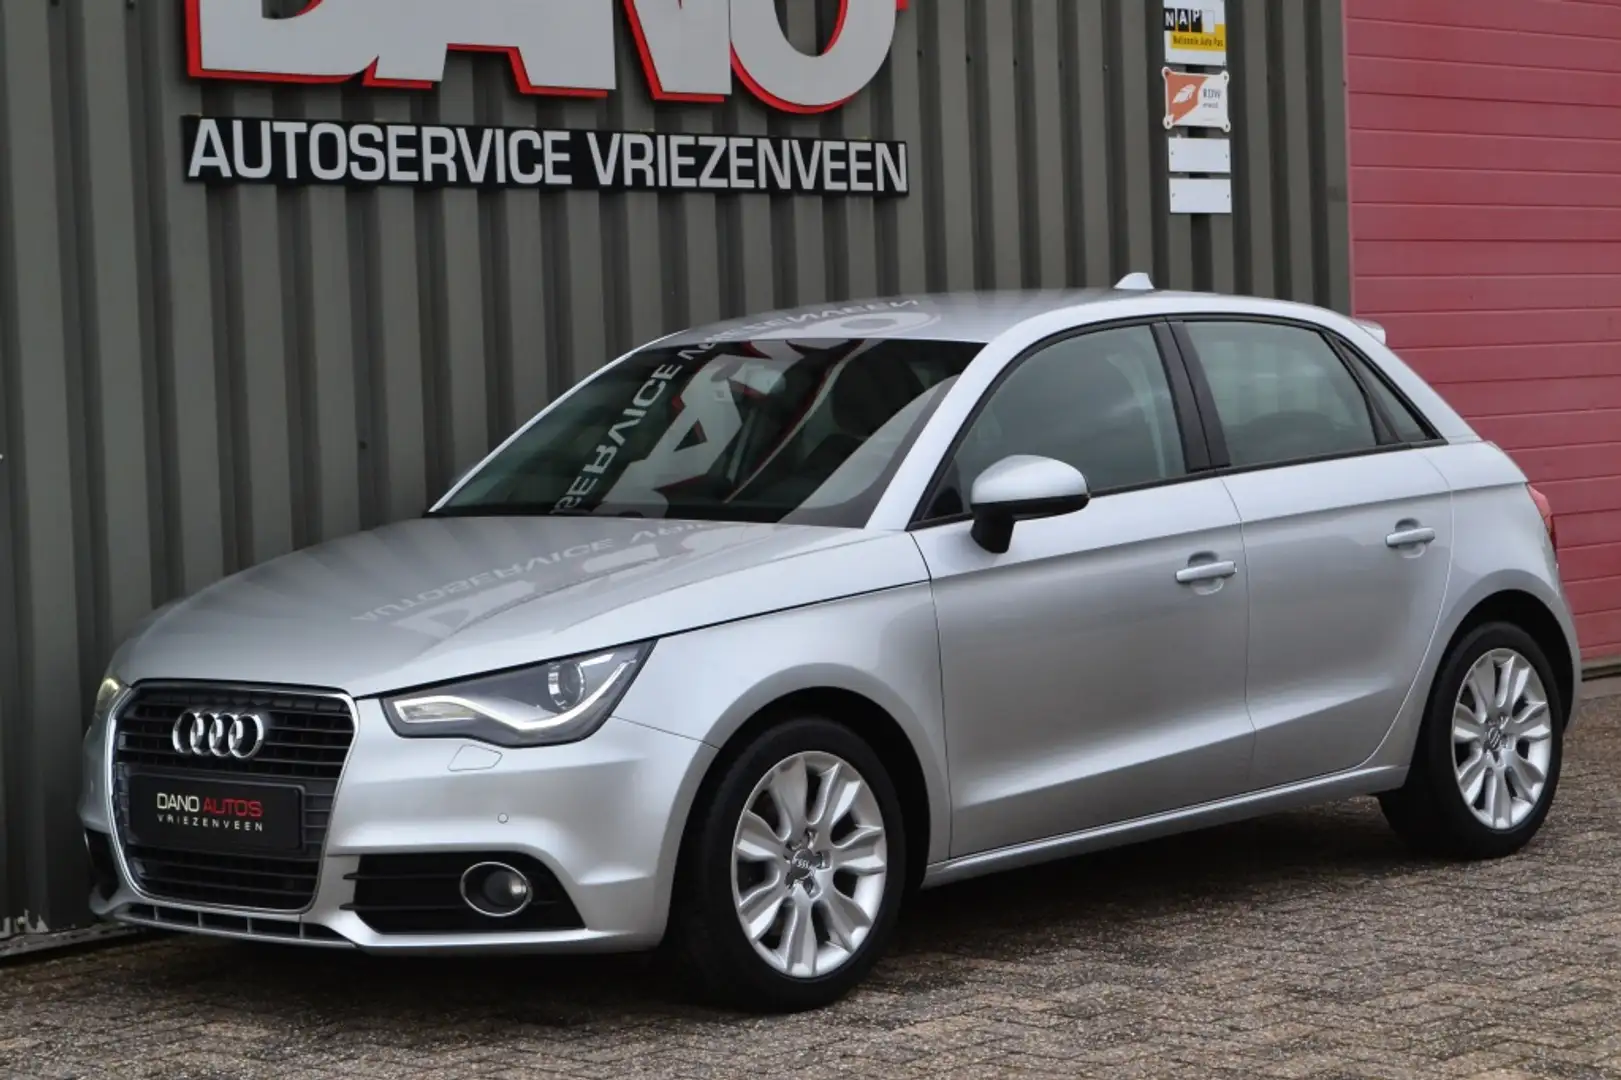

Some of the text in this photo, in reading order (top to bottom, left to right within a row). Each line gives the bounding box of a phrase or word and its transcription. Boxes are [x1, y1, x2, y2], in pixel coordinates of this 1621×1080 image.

[1164, 9, 1202, 29] NAP
[187, 117, 908, 193] AUTOSERVICE VRIEZENVEEN
[156, 792, 264, 818] DANO AUTOS
[157, 814, 263, 832] VRIEZENVEEN
